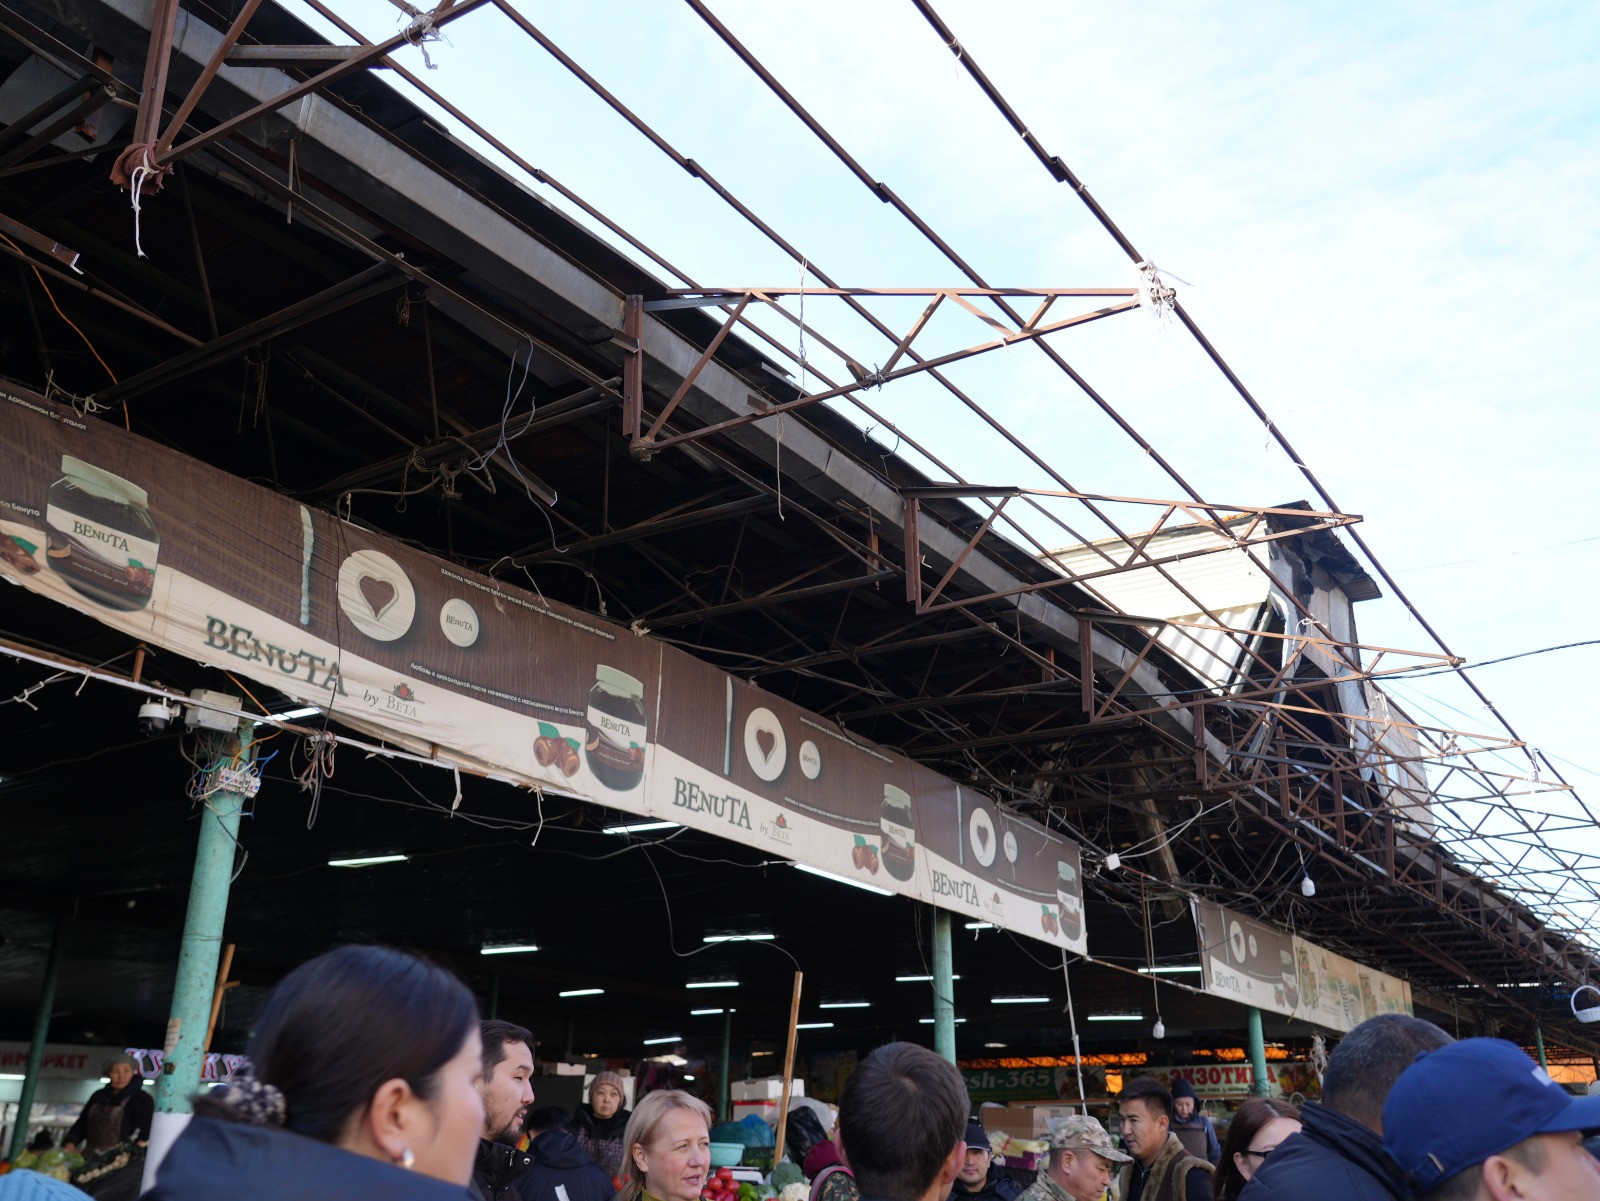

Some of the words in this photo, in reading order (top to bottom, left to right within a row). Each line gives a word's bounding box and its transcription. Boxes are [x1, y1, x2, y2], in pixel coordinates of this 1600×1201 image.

[49, 411, 87, 431] баталат
[12, 503, 40, 517] Бенута
[73, 520, 129, 552] BENUTA
[446, 614, 473, 632] BENUTA
[203, 615, 349, 698] BENUTA
[363, 690, 380, 708] by
[386, 695, 417, 717] BETA
[410, 662, 432, 676] Любовь
[601, 716, 631, 737] BENUTA
[672, 777, 753, 831] BENUTA
[760, 821, 769, 836] by
[932, 869, 980, 907] BENUTA
[1169, 1065, 1277, 1086] ЭКЗОТИА
